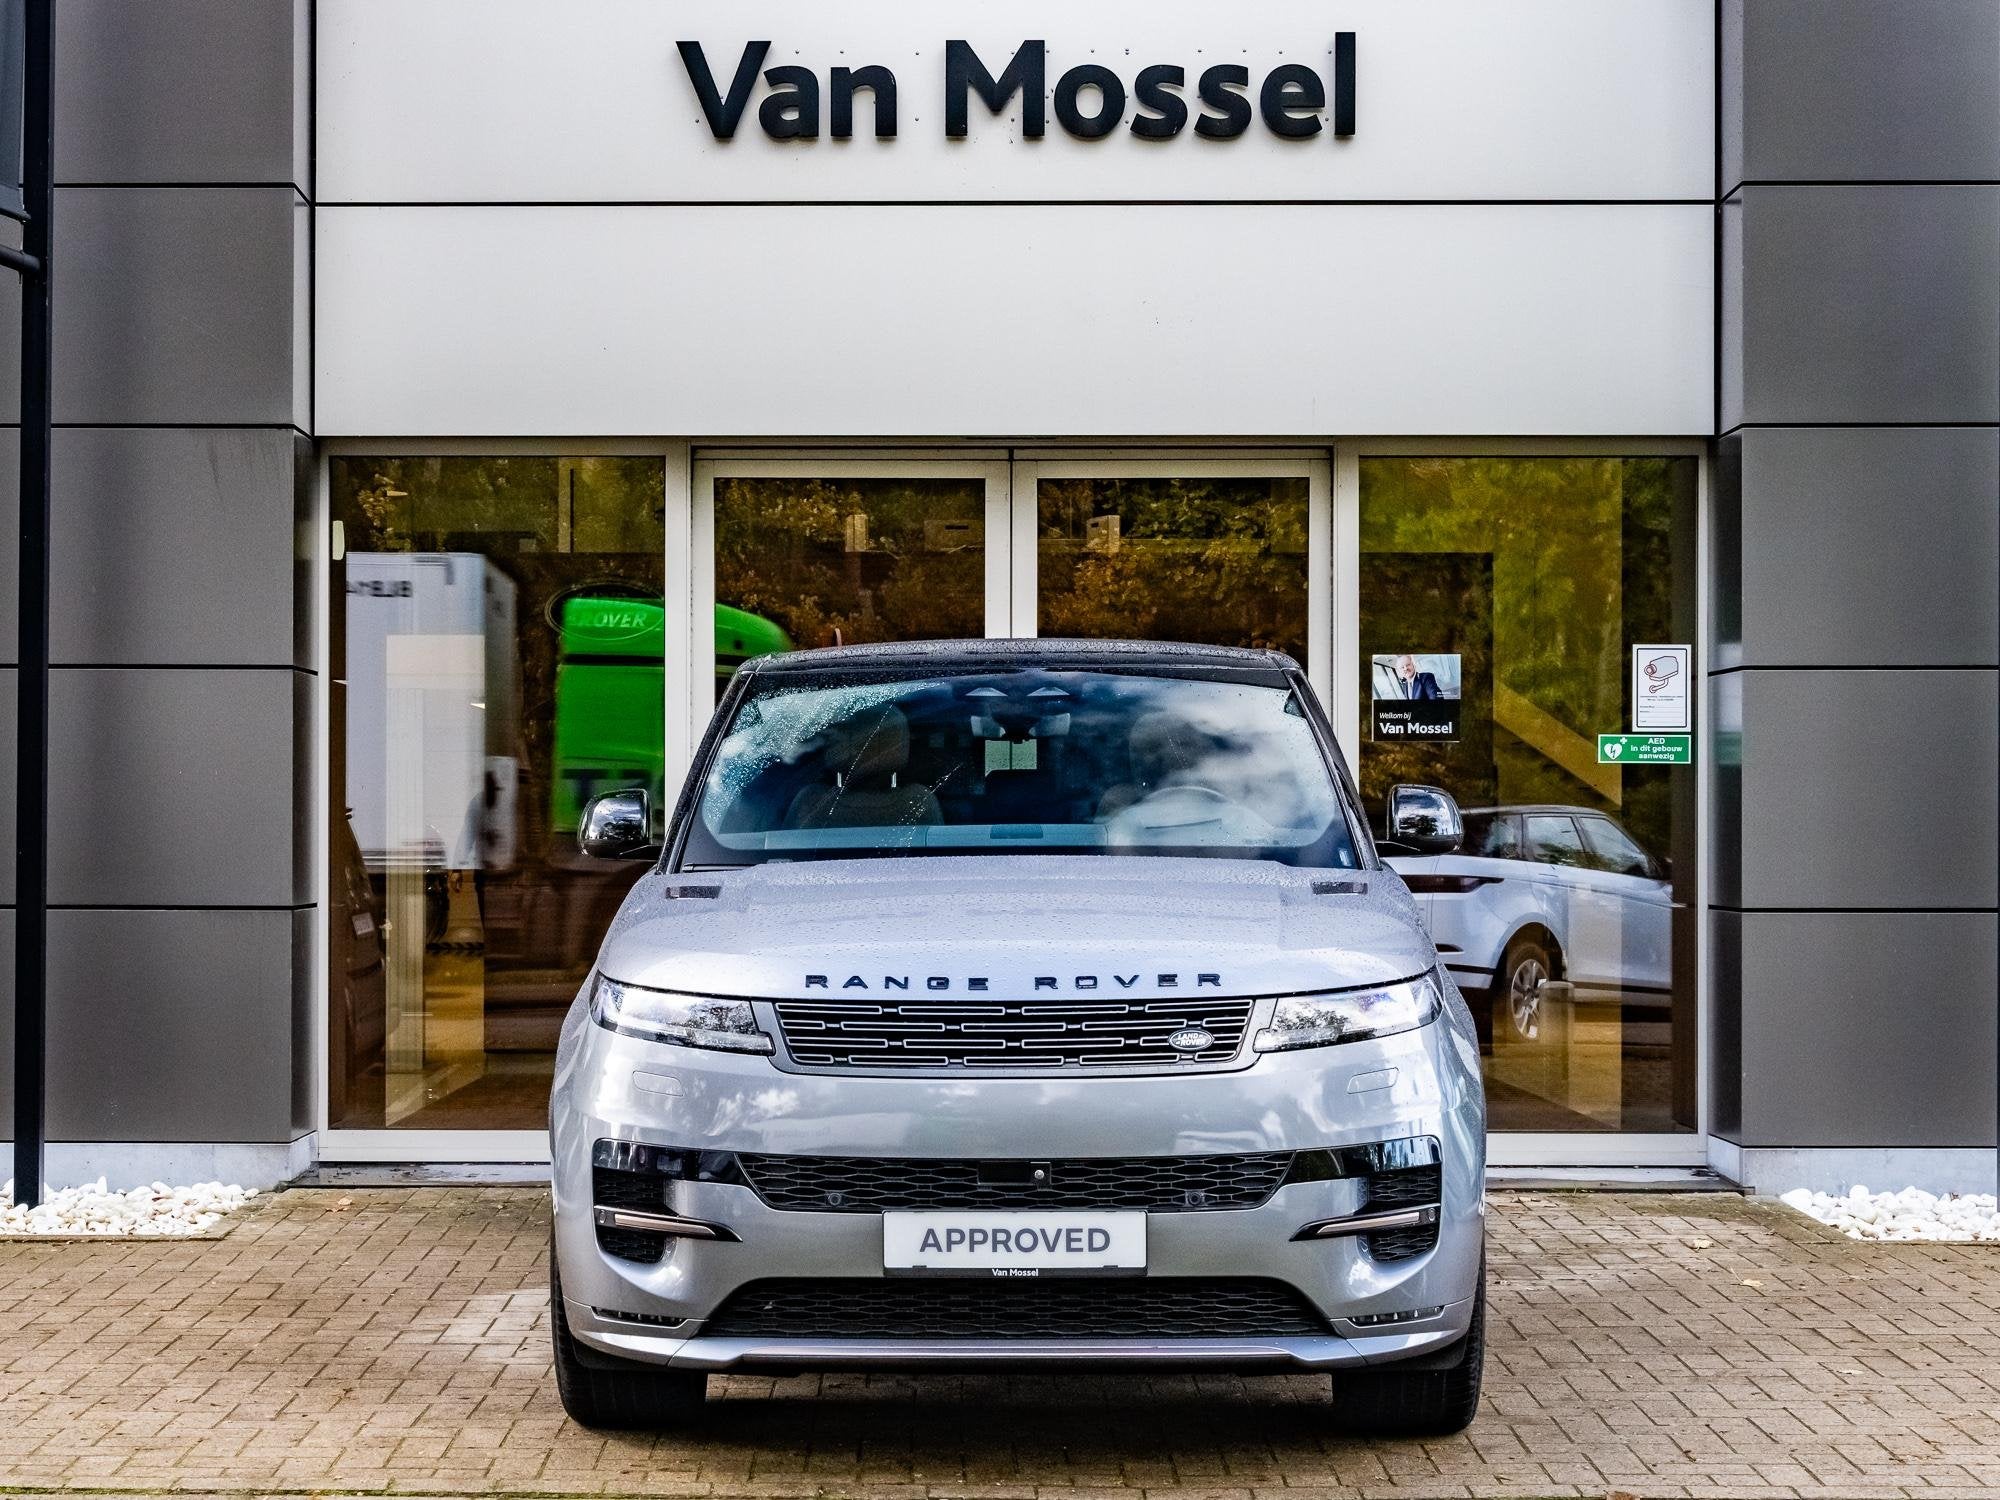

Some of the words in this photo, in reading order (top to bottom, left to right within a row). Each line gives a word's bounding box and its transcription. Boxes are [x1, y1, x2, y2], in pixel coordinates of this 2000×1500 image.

[676, 41, 898, 139] Van
[945, 32, 1356, 138] Mossel
[1403, 712, 1412, 721] bij
[1379, 722, 1404, 734] Van
[1407, 721, 1453, 734] Mossel
[1652, 745, 1683, 753] gebouw
[805, 974, 989, 991] RANGE
[1034, 973, 1222, 991] ROVER
[919, 1227, 1111, 1253] APPROVED
[991, 1268, 1008, 1277] Van
[1009, 1268, 1039, 1277] Mossel
